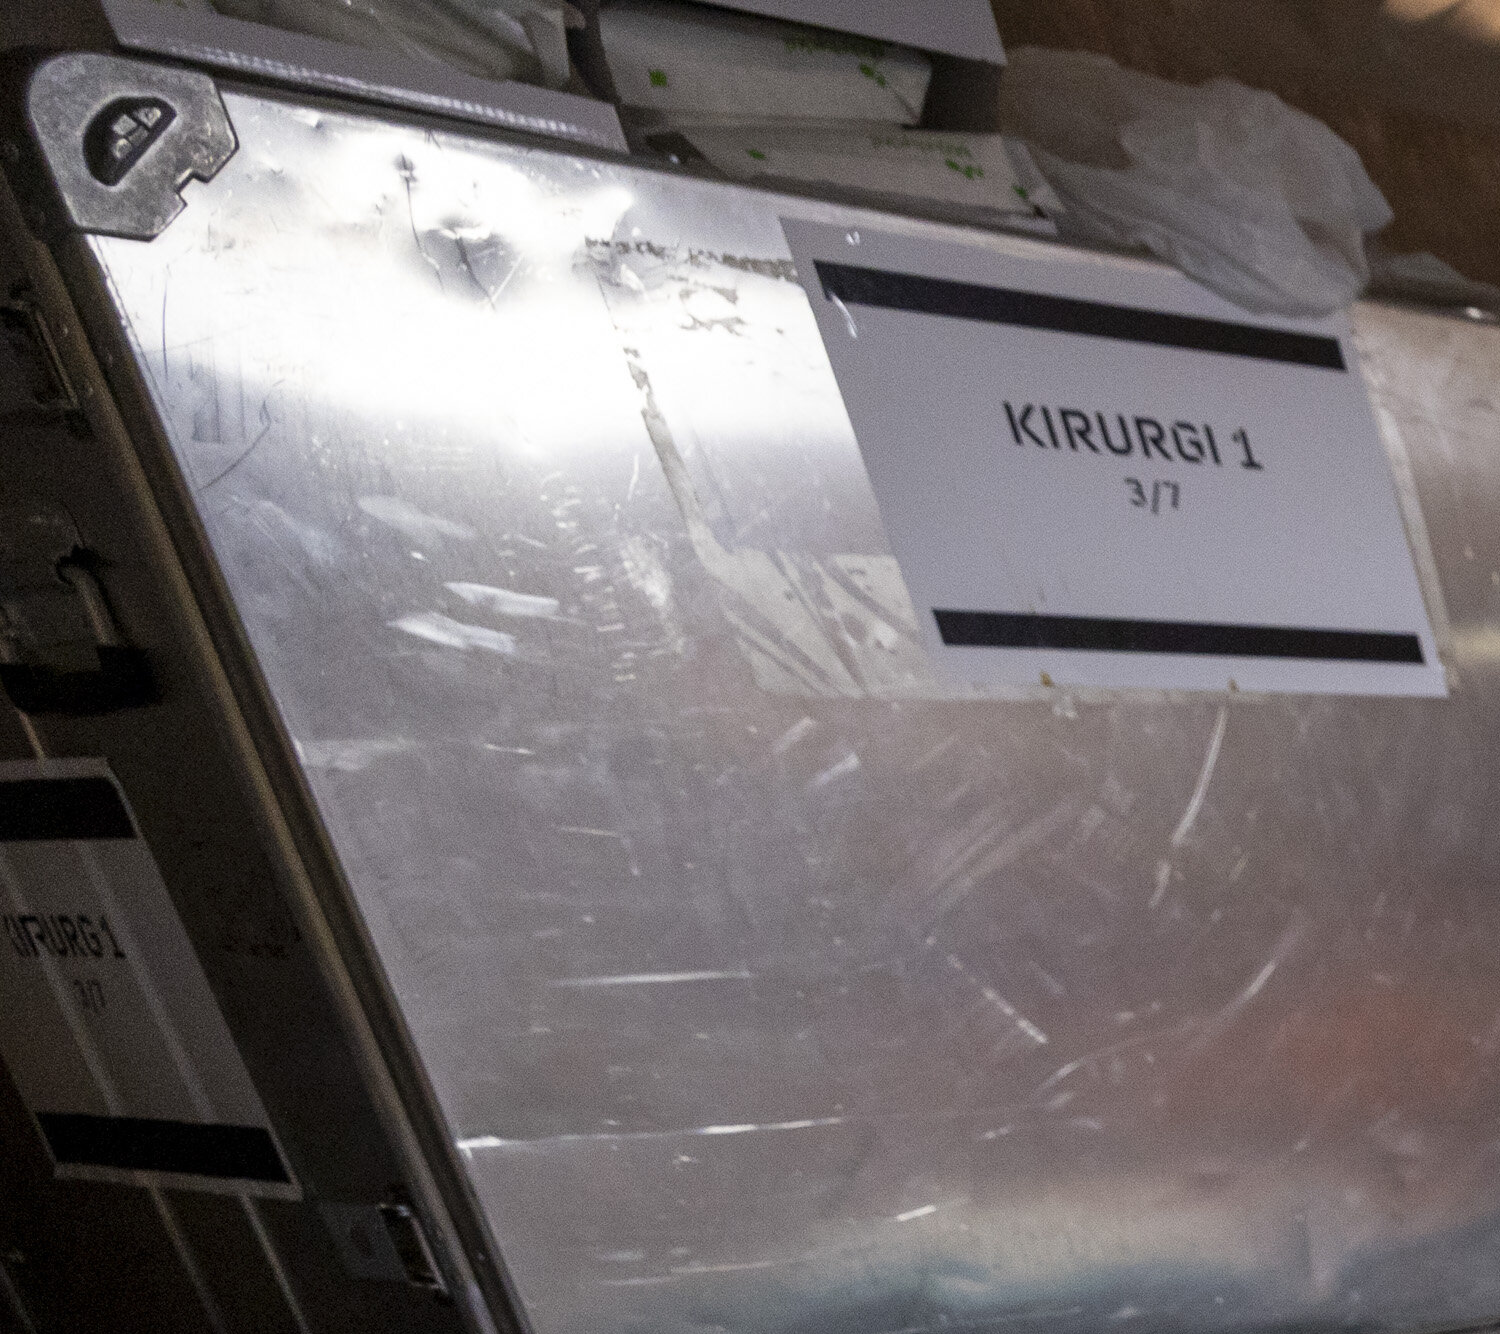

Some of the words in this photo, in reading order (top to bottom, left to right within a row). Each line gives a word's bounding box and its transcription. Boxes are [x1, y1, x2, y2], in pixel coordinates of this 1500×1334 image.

[1003, 401, 1222, 466] KIRURGI
[1232, 427, 1263, 471] 1
[1124, 477, 1180, 514] 3/7
